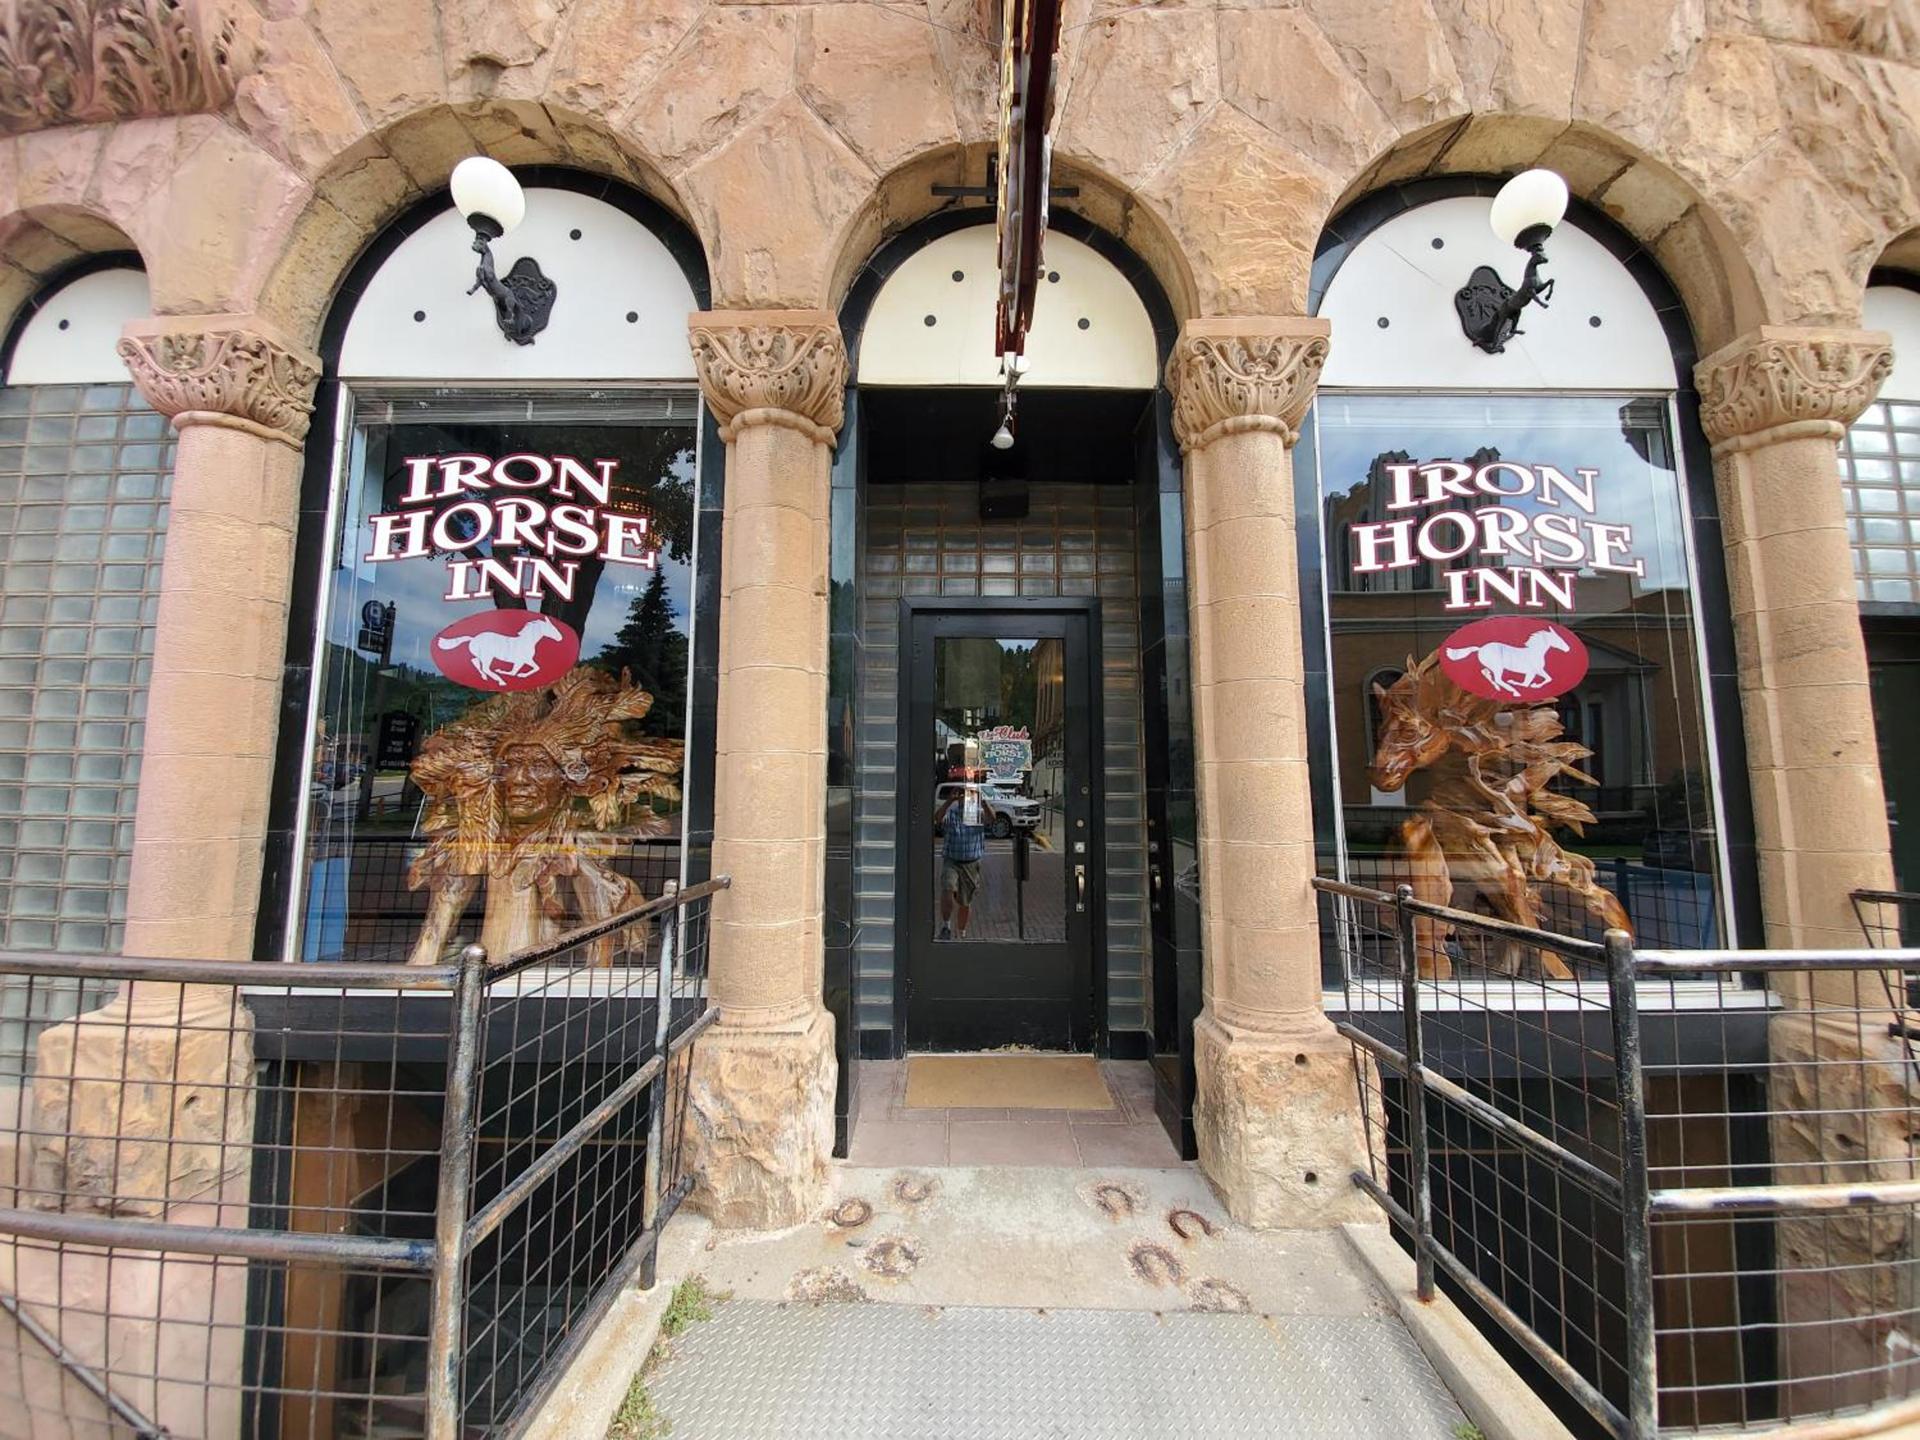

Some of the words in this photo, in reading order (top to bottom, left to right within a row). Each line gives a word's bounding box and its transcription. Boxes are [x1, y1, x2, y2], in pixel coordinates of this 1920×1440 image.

[402, 454, 619, 507] IRON
[1385, 461, 1600, 516] IRON
[364, 497, 657, 570] HORSE
[1351, 506, 1645, 579] HORSE
[444, 555, 580, 602] INN
[1443, 565, 1578, 611] INN
[985, 750, 1025, 759] HORSE
